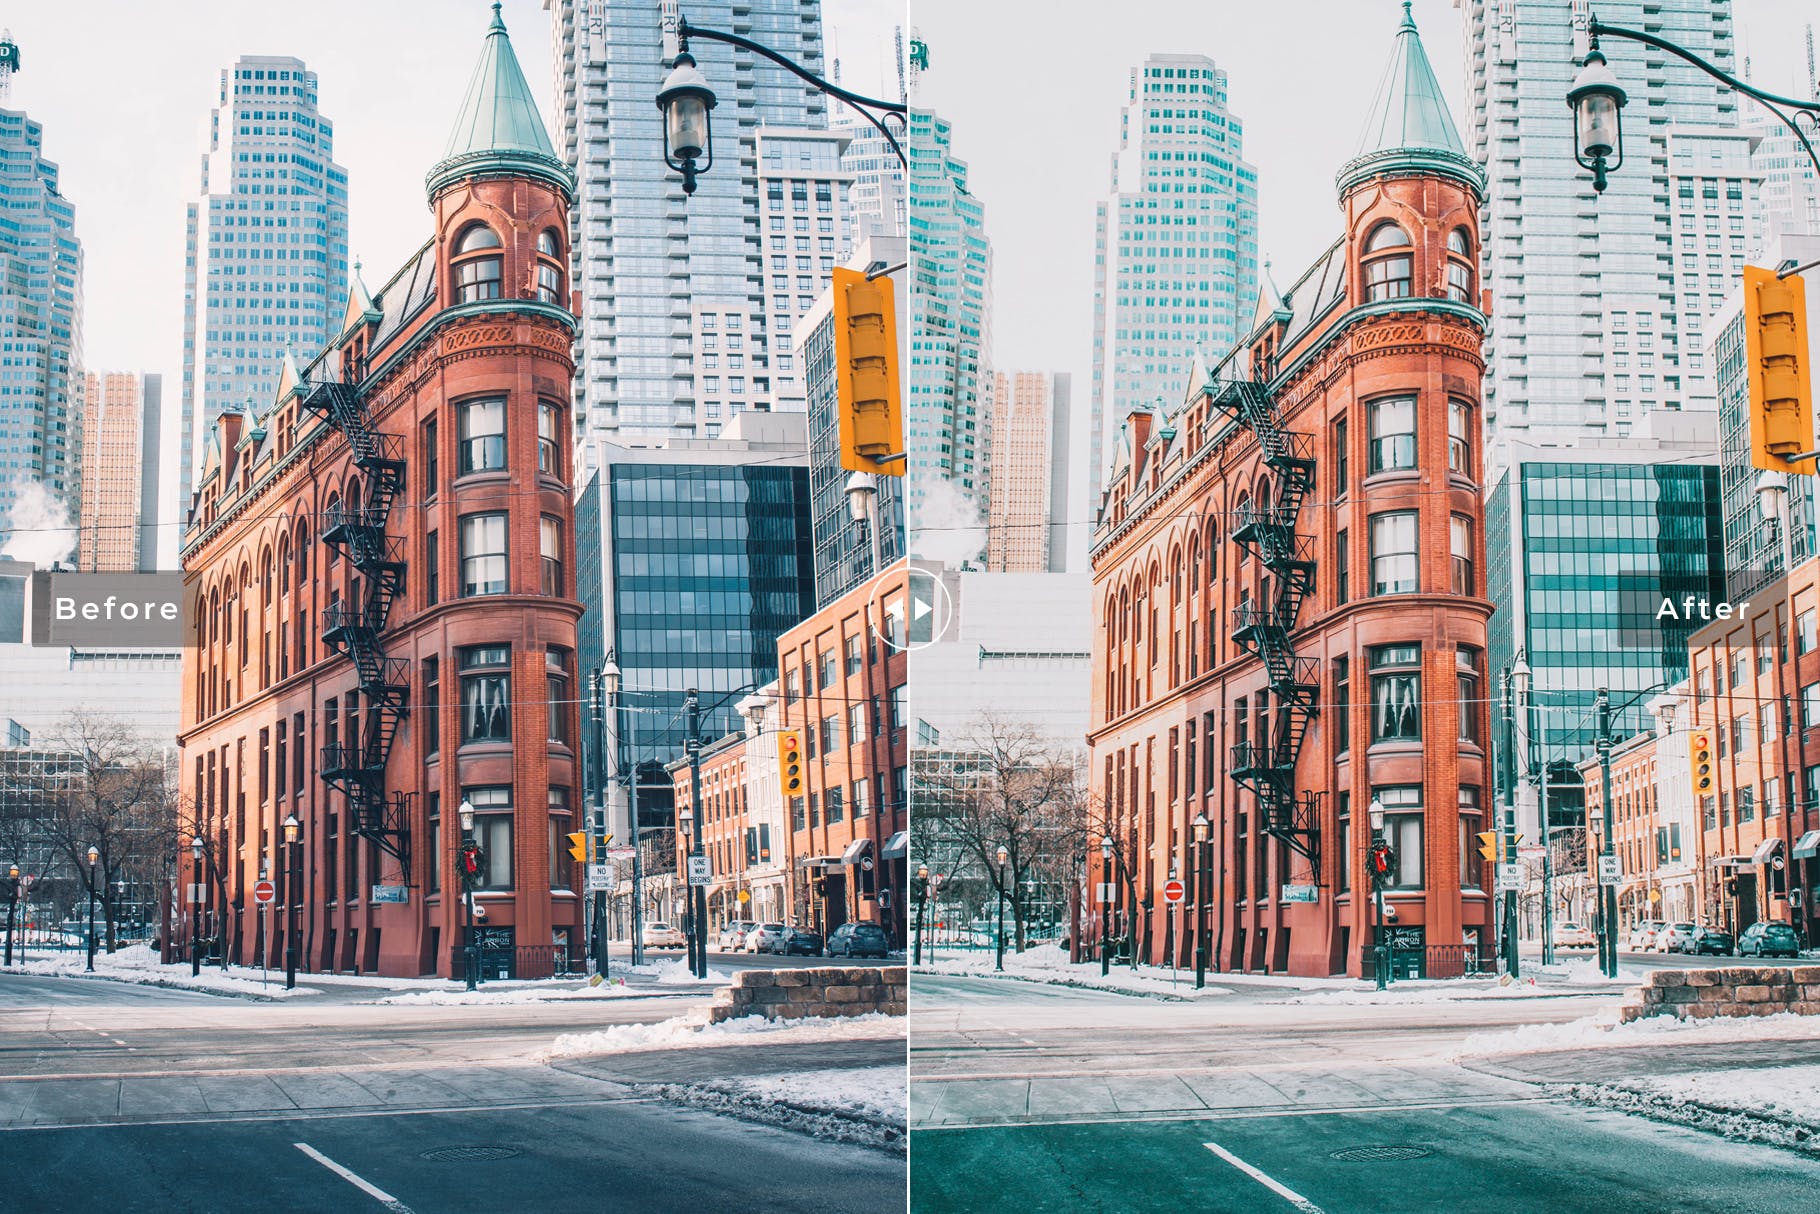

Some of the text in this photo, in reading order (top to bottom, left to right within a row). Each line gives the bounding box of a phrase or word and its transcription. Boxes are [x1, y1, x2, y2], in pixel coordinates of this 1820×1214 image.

[694, 858, 705, 866] ONE
[1604, 857, 1616, 865] ONE
[597, 867, 606, 875] NO
[1507, 866, 1518, 874] NO
[690, 876, 711, 884] BEGINS
[1600, 875, 1621, 883] BEGINS
